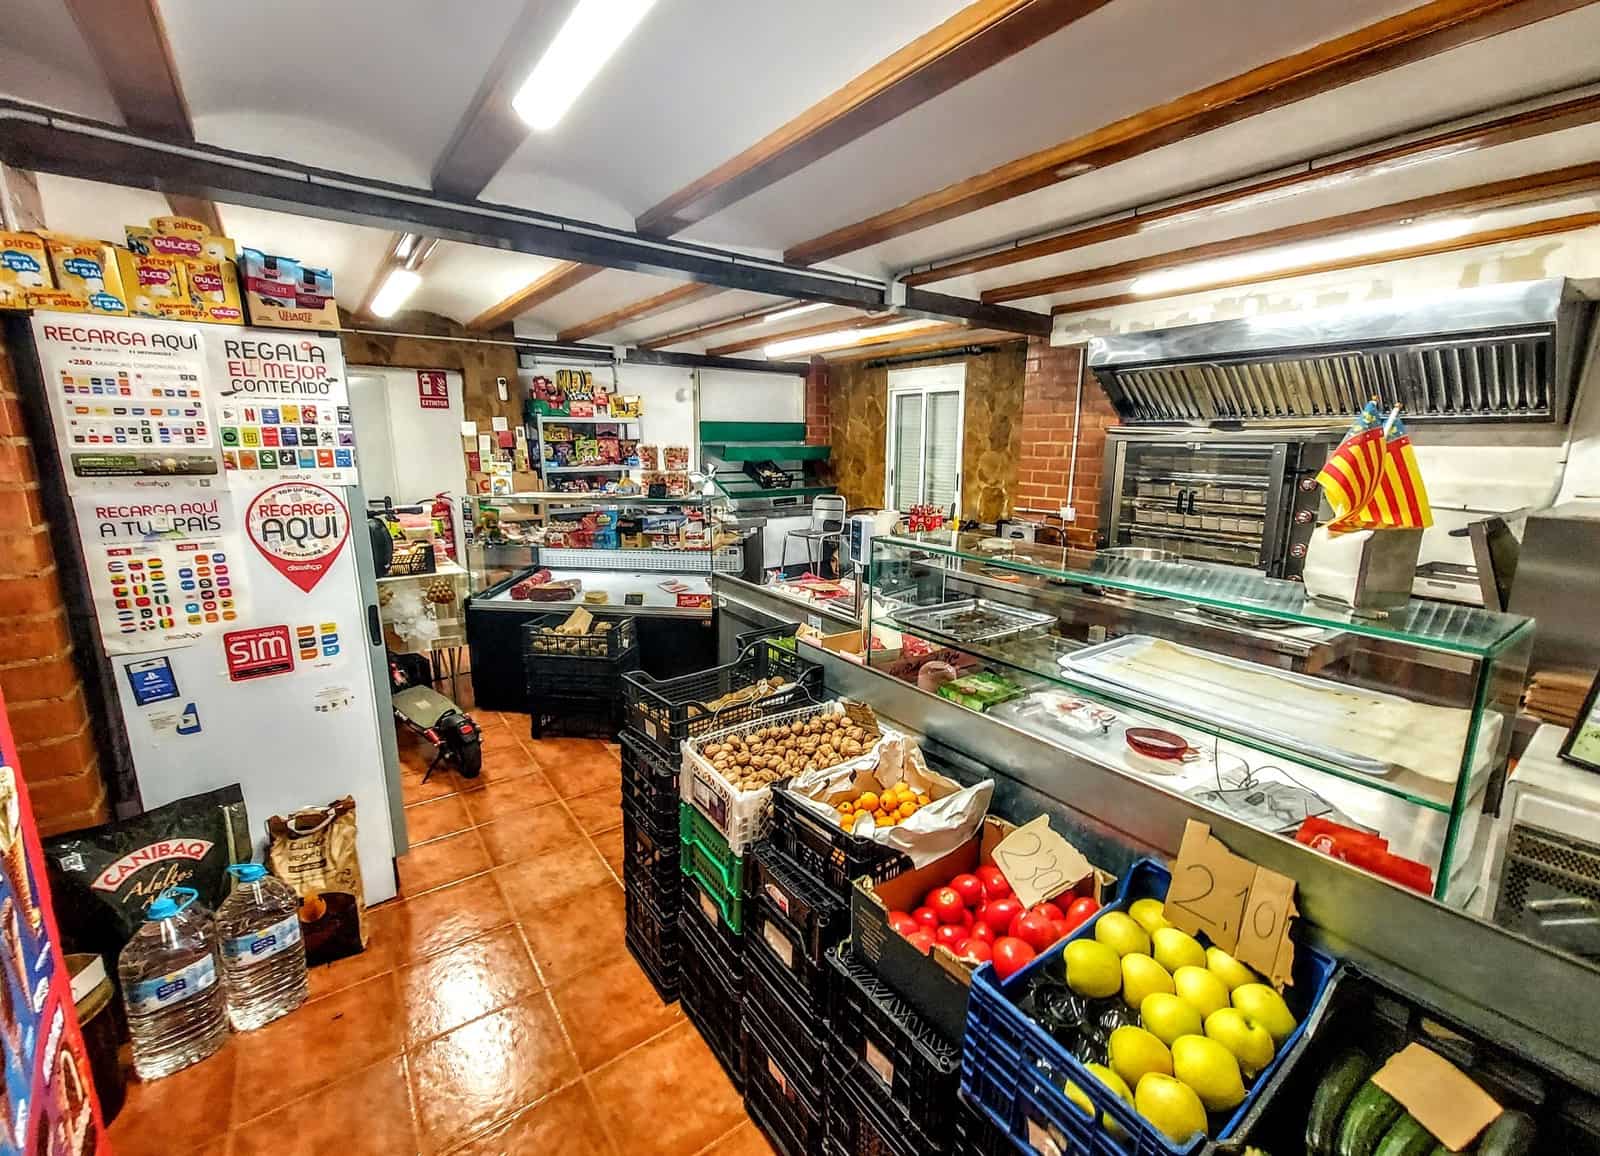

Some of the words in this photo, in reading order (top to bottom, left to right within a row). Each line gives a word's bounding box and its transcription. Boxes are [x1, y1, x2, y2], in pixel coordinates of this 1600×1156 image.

[154, 239, 201, 252] DULCES
[44, 325, 147, 347] RECARGA
[224, 340, 326, 364] REGALA
[228, 361, 257, 378] EL
[263, 362, 328, 381] MEJOR
[231, 379, 330, 395] CONTENIDO
[95, 503, 177, 519] RECARGA
[259, 503, 336, 517] RECARGA
[100, 522, 117, 538] A
[229, 635, 288, 665] SIM
[103, 842, 205, 885] CANIBAQ
